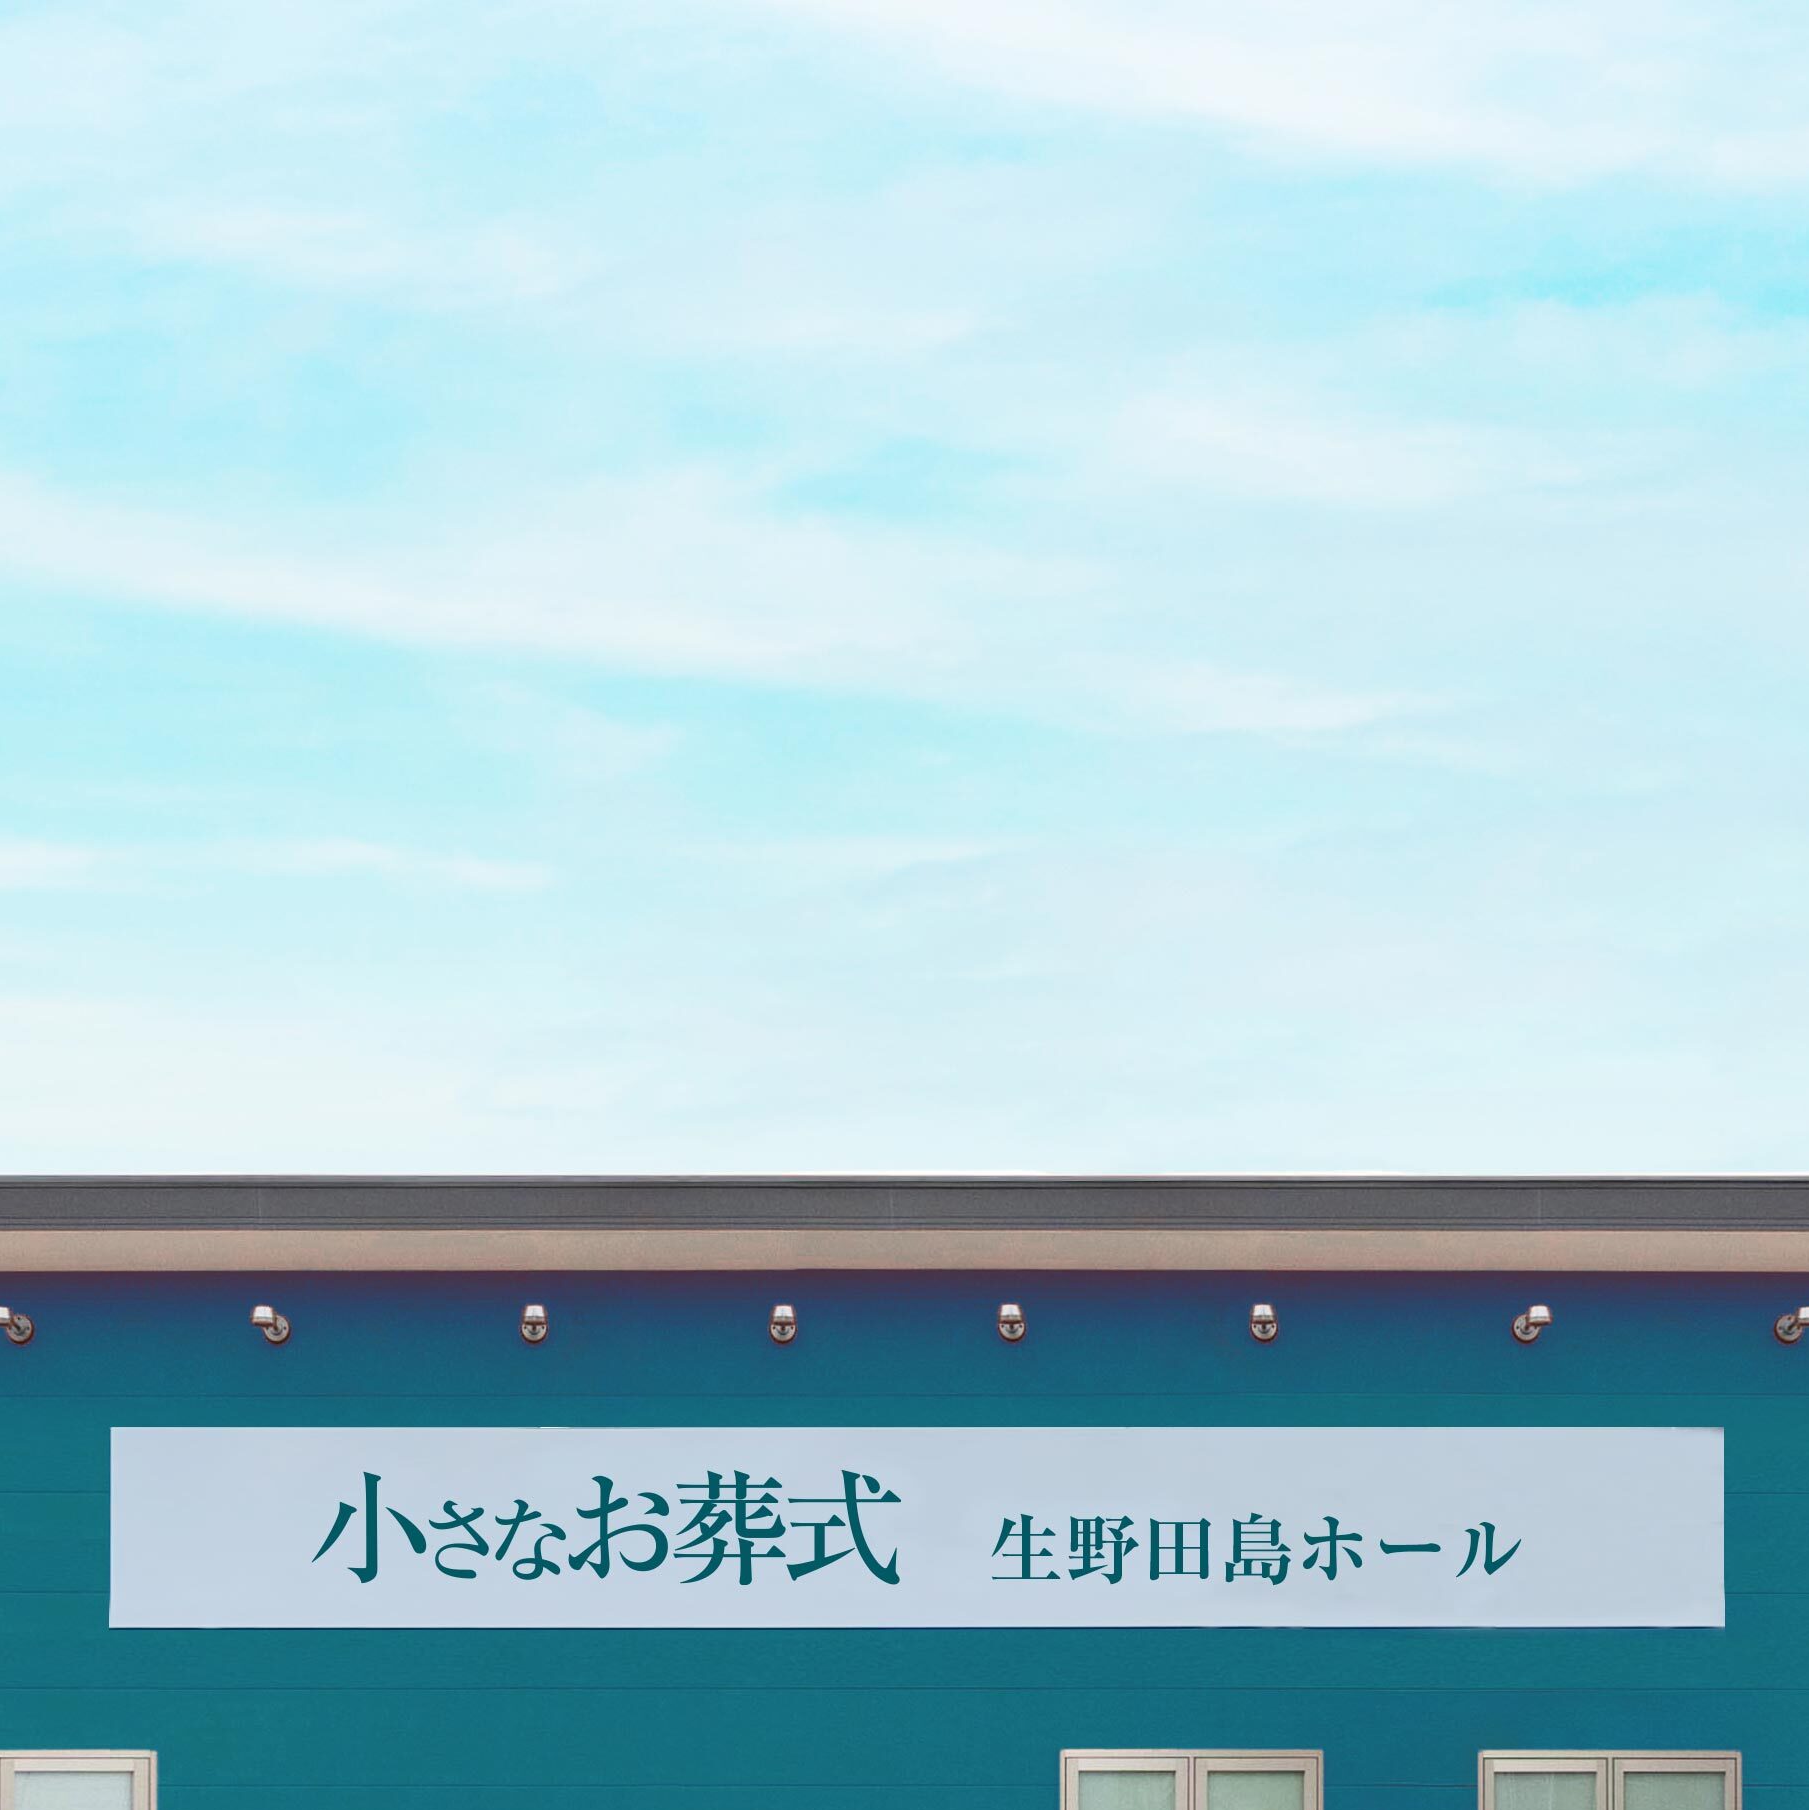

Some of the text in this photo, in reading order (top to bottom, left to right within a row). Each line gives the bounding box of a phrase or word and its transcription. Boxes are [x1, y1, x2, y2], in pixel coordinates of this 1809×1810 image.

[311, 1470, 1523, 1586] 小さなお葬式 生野田島ホール
